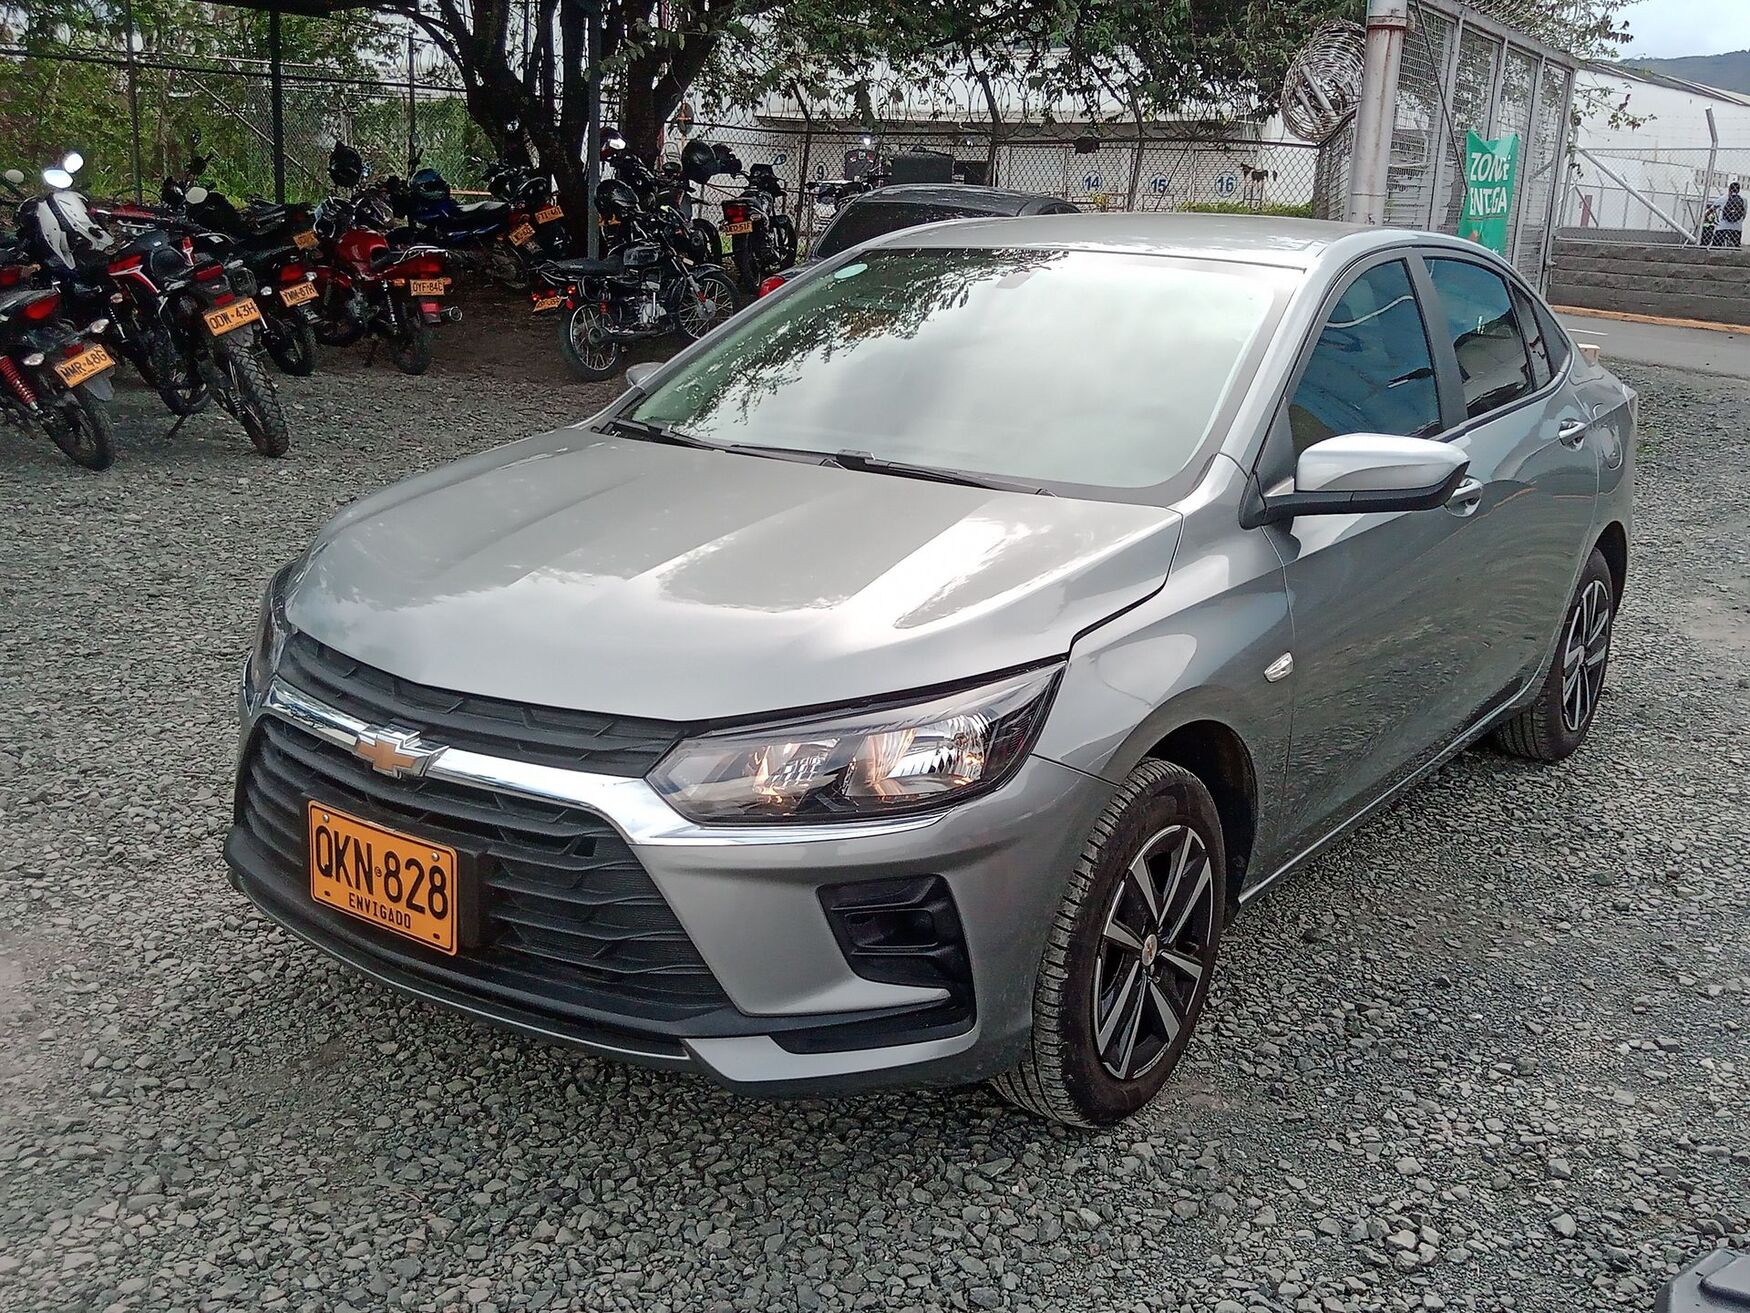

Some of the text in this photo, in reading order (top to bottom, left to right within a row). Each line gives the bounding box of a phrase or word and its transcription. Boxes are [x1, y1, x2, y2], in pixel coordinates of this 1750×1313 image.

[1084, 176, 1100, 191] 14
[1151, 177, 1168, 193] 15
[1217, 176, 1235, 193] 16
[348, 892, 411, 929] ENVIGADO
